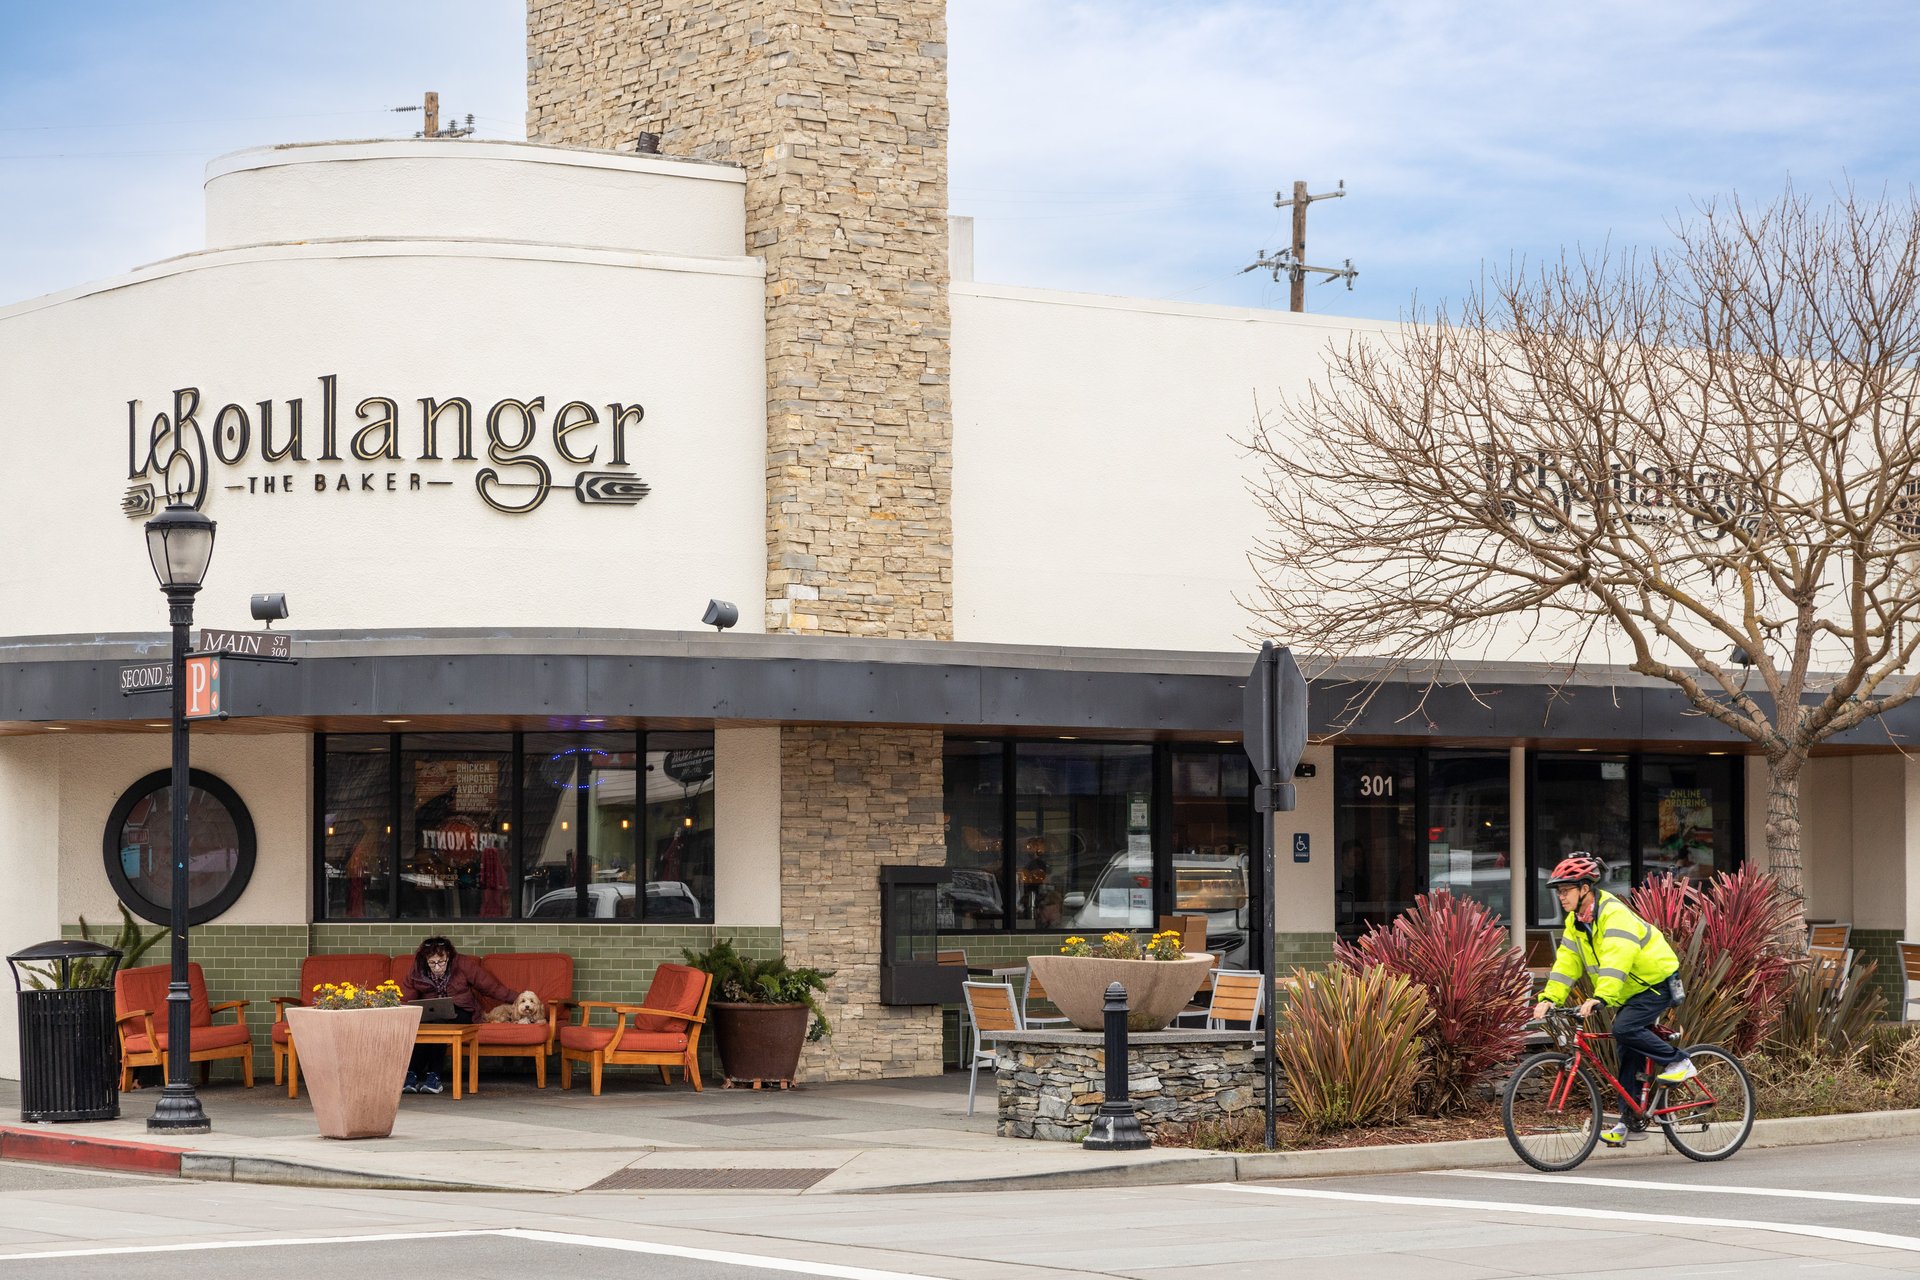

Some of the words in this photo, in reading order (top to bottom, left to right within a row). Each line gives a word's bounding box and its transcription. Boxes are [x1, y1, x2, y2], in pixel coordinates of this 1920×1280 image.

[248, 475, 293, 494] THE
[315, 473, 421, 492] BAKER
[204, 632, 262, 654] MAIN
[273, 636, 286, 646] ST
[271, 647, 287, 657] 300
[121, 667, 163, 689] SECOND
[190, 663, 206, 712] P
[456, 763, 490, 773] CHICKEN
[456, 774, 494, 784] CHIPOTLE
[456, 784, 494, 794] AVOCADO
[1360, 775, 1393, 797] 301
[1670, 789, 1702, 798] ONLINE
[1664, 799, 1707, 808] ORDERING
